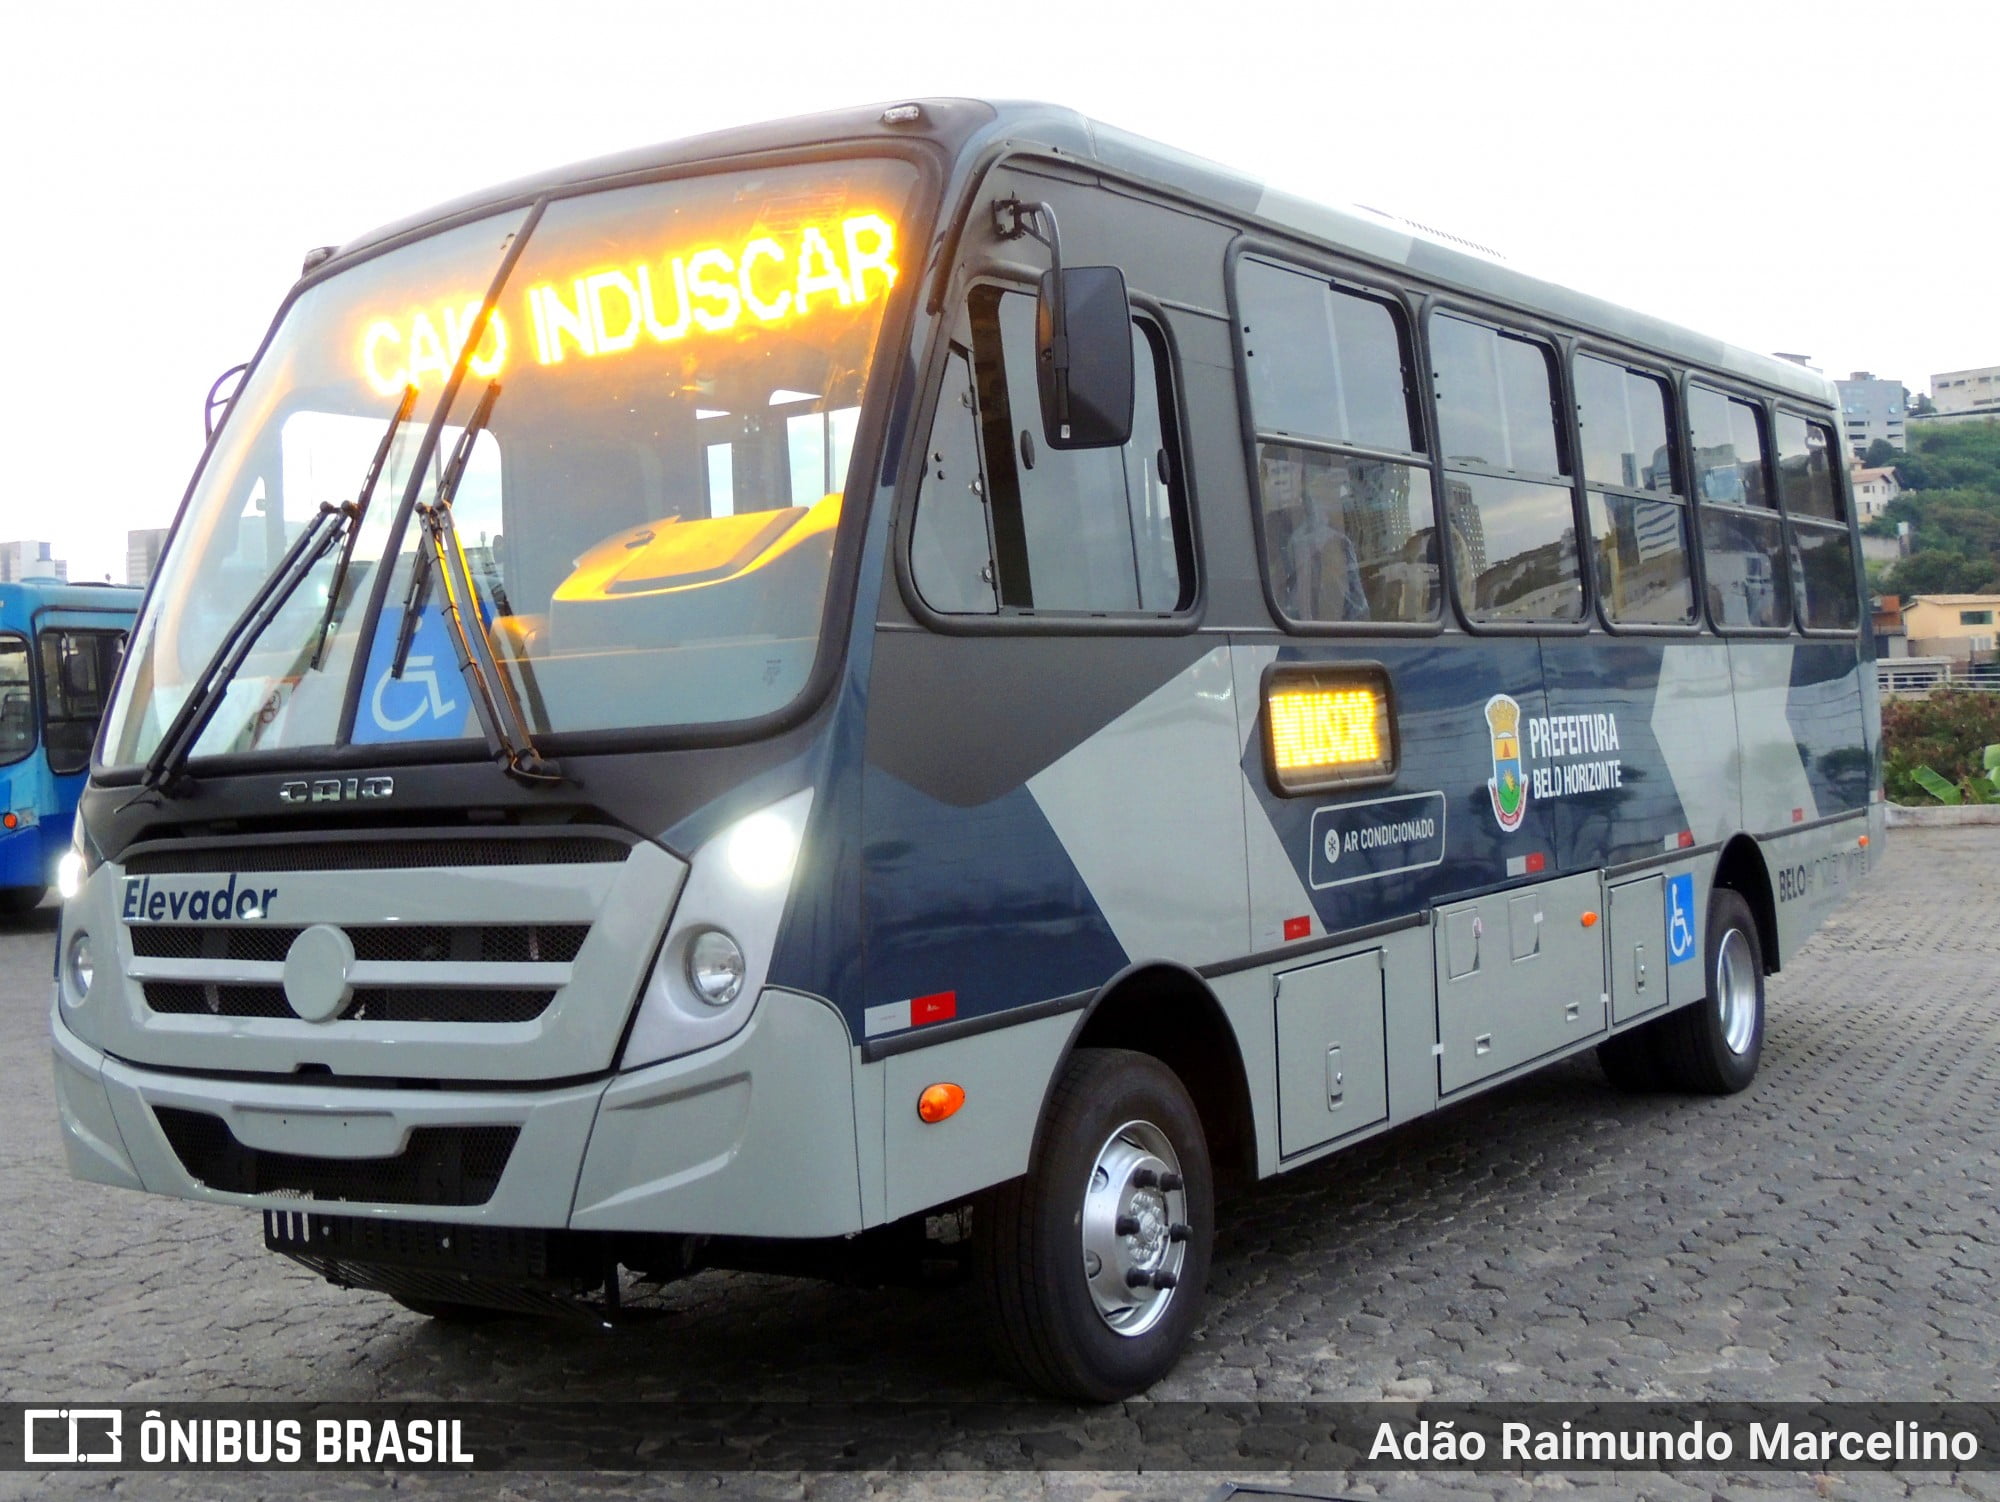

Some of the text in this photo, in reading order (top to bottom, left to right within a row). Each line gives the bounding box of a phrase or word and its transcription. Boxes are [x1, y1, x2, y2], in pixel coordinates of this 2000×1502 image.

[362, 213, 899, 396] CAIO INDUSCAR
[1529, 713, 1620, 759] PREFEITURA
[280, 776, 394, 802] CAIO
[1533, 760, 1623, 799] BELO HORIZONTE
[1344, 818, 1435, 852] AR CONDICIONADO
[122, 873, 278, 921] Elevador
[1779, 864, 1806, 902] BELO
